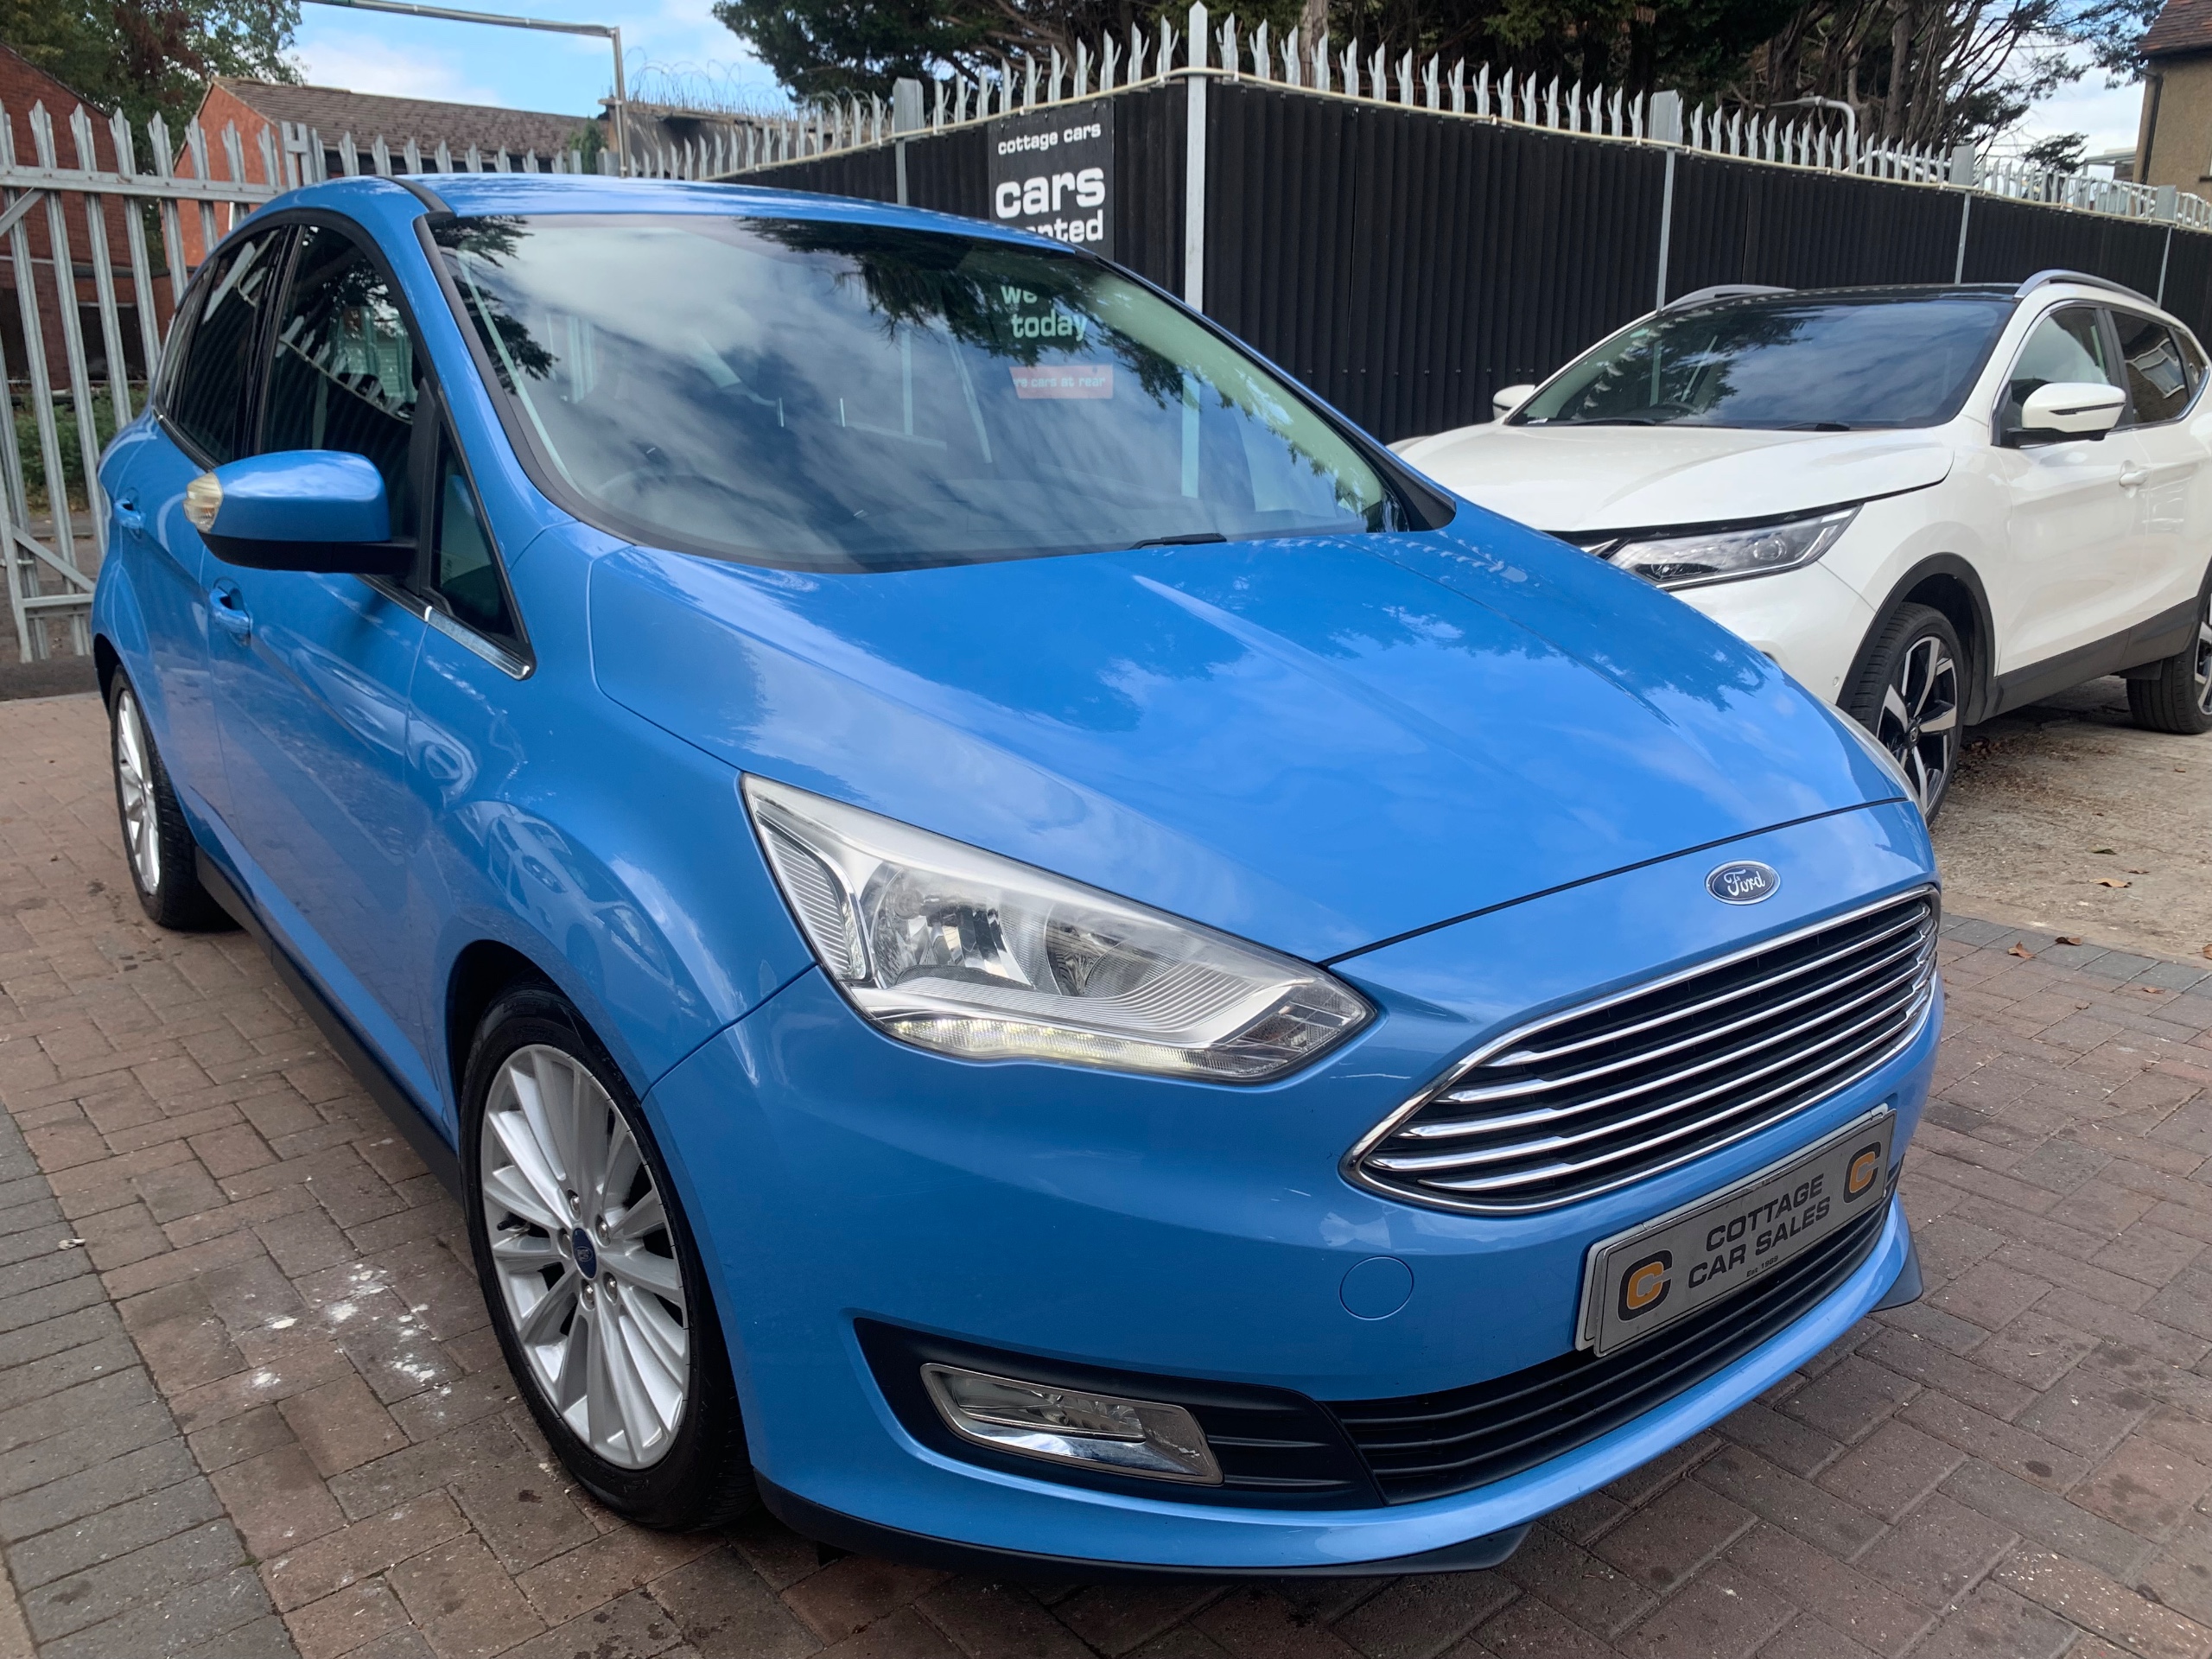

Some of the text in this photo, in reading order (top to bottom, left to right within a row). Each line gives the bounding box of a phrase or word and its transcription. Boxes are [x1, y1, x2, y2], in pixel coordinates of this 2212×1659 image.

[998, 123, 1102, 156] cottage cars
[995, 167, 1106, 219] cars
[1011, 308, 1088, 342] today
[1031, 377, 1058, 388] cars
[1060, 376, 1076, 388] at
[1078, 377, 1106, 388] rear
[1723, 869, 1766, 896] Ford
[1706, 1173, 1824, 1252] COTTAGE
[1688, 1197, 1831, 1289] CAR SALES
